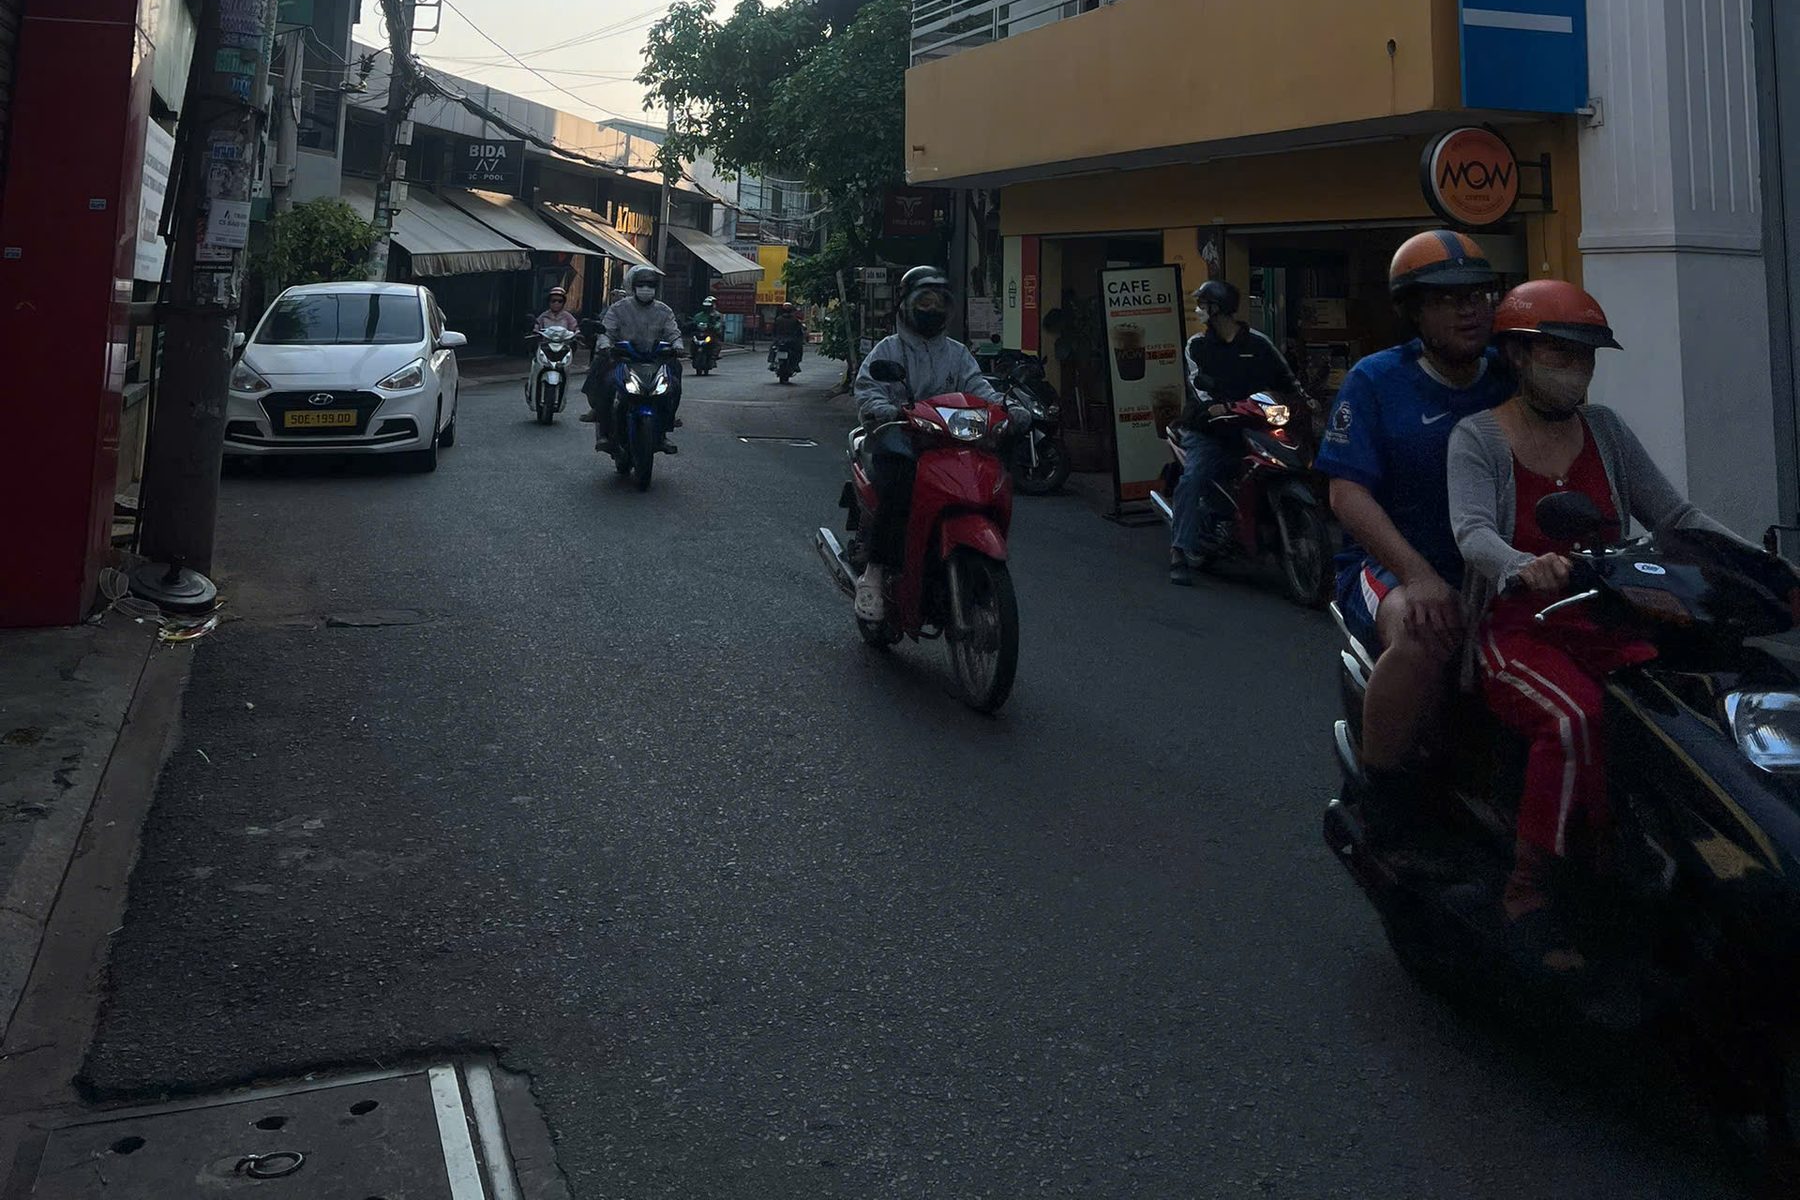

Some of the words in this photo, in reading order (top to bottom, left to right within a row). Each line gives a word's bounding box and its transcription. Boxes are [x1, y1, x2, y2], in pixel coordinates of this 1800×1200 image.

[469, 144, 507, 158] BIDA
[483, 173, 504, 181] POOL
[1107, 279, 1152, 294] CAFE
[1108, 294, 1153, 308] MANG
[1156, 293, 1172, 304] ĐI
